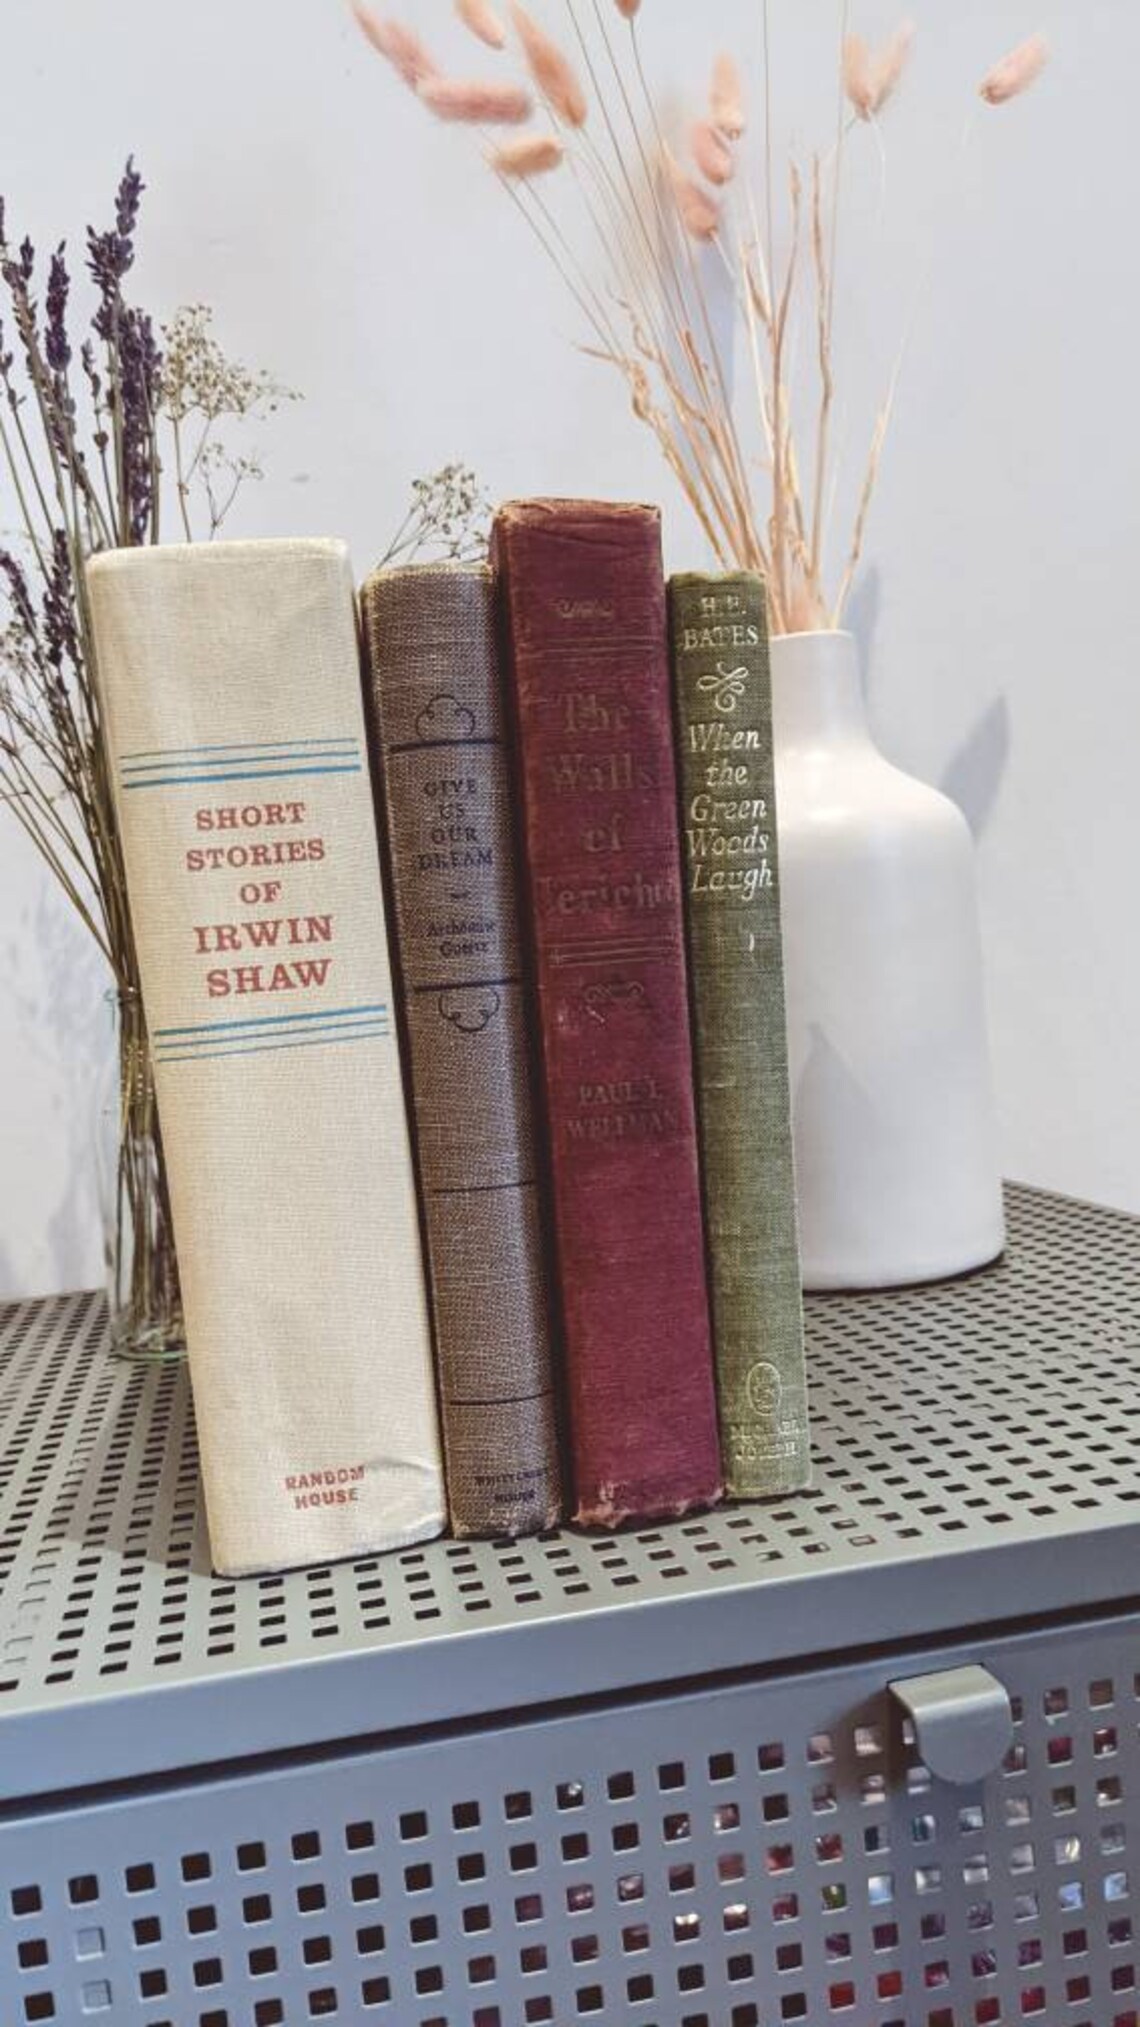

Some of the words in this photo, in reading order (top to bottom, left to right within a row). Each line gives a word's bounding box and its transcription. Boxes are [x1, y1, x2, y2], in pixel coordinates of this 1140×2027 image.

[683, 624, 759, 651] BATES
[689, 722, 761, 752] When
[706, 758, 748, 787] the
[423, 778, 478, 797] GIVE
[195, 801, 307, 831] SHORT
[690, 794, 767, 822] Green
[431, 825, 478, 845] OUR
[686, 826, 769, 857] Woods
[186, 838, 326, 872] STORIES
[417, 847, 493, 870] DREAM
[239, 880, 282, 905] OF
[691, 858, 774, 900] Laugh
[192, 914, 334, 954] IRWIN
[206, 958, 333, 998] SHAW
[285, 1465, 365, 1490] RANDOM
[294, 1487, 359, 1510] HOUSE
